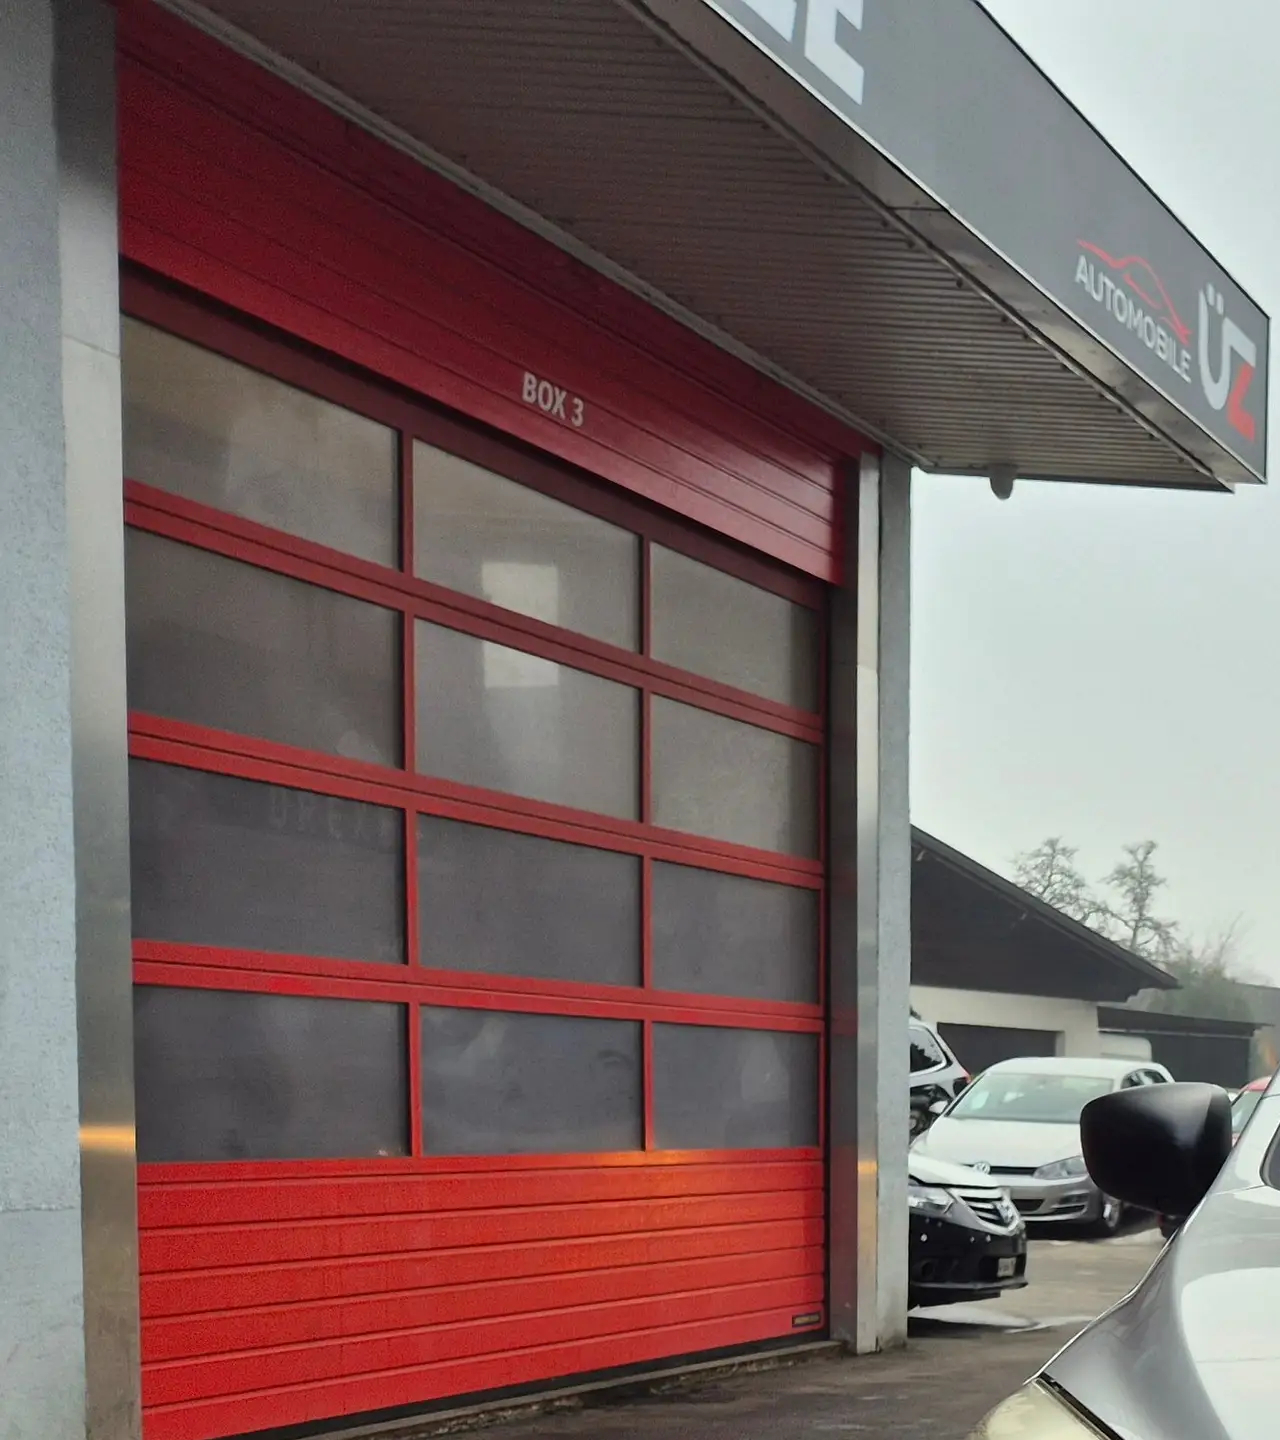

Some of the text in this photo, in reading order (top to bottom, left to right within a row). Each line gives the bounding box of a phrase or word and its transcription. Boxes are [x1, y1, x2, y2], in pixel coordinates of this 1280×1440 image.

[1074, 254, 1192, 384] AUTOMOBILE
[1198, 283, 1257, 442] ÜZ
[522, 371, 585, 427] BOX 3
